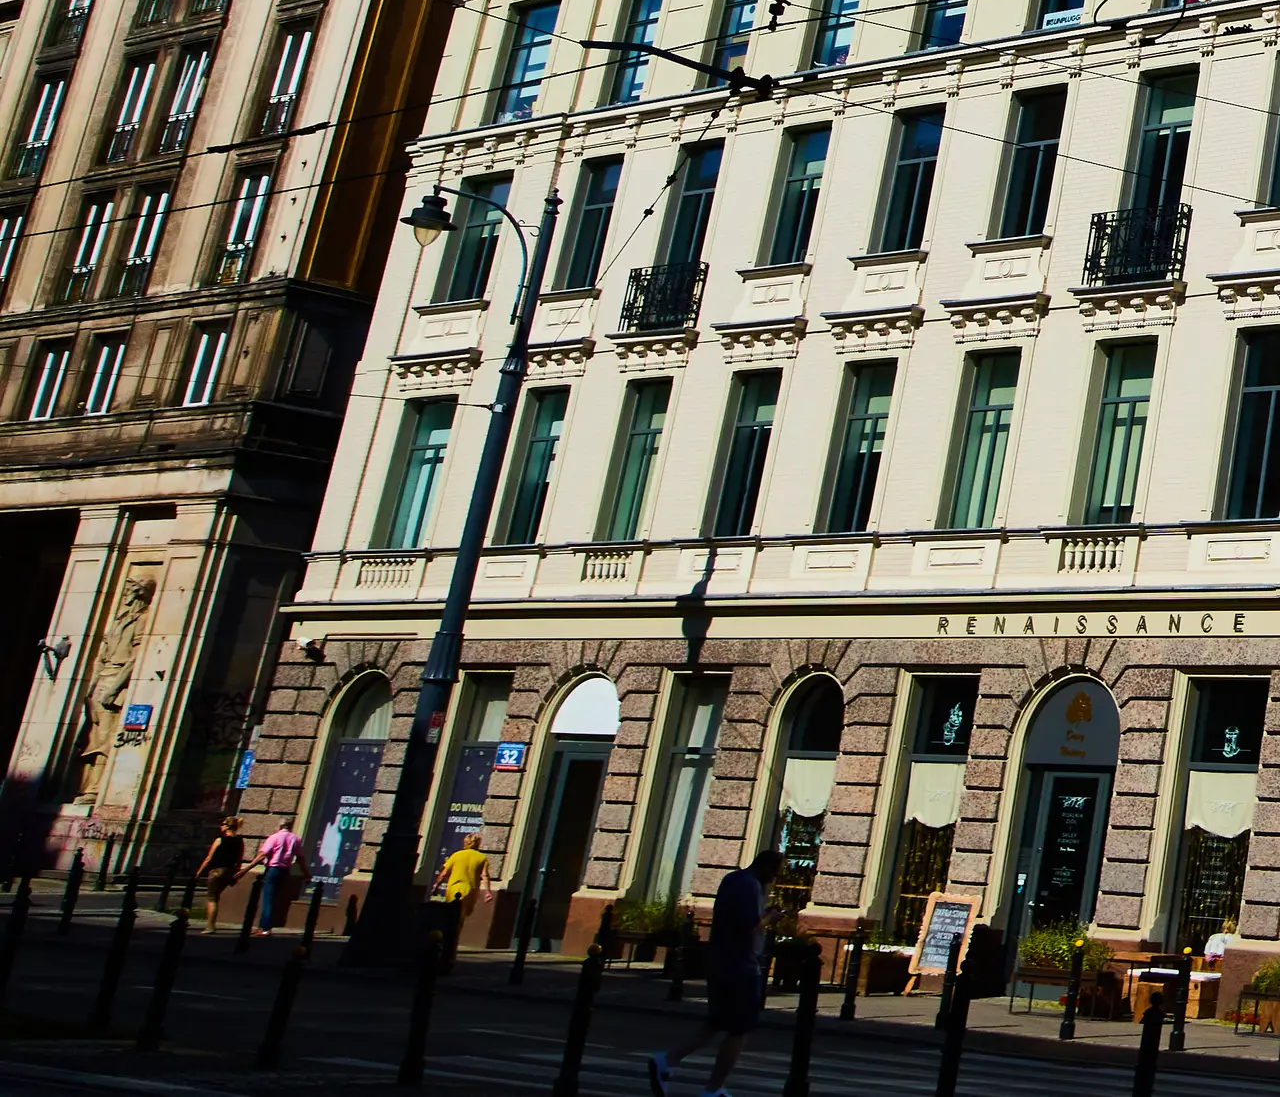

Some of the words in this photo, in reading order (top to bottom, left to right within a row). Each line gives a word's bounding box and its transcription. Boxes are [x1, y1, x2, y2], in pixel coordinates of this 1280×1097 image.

[937, 613, 1245, 635] RENAISSANCE
[500, 750, 518, 764] 32
[349, 817, 369, 831] LET
